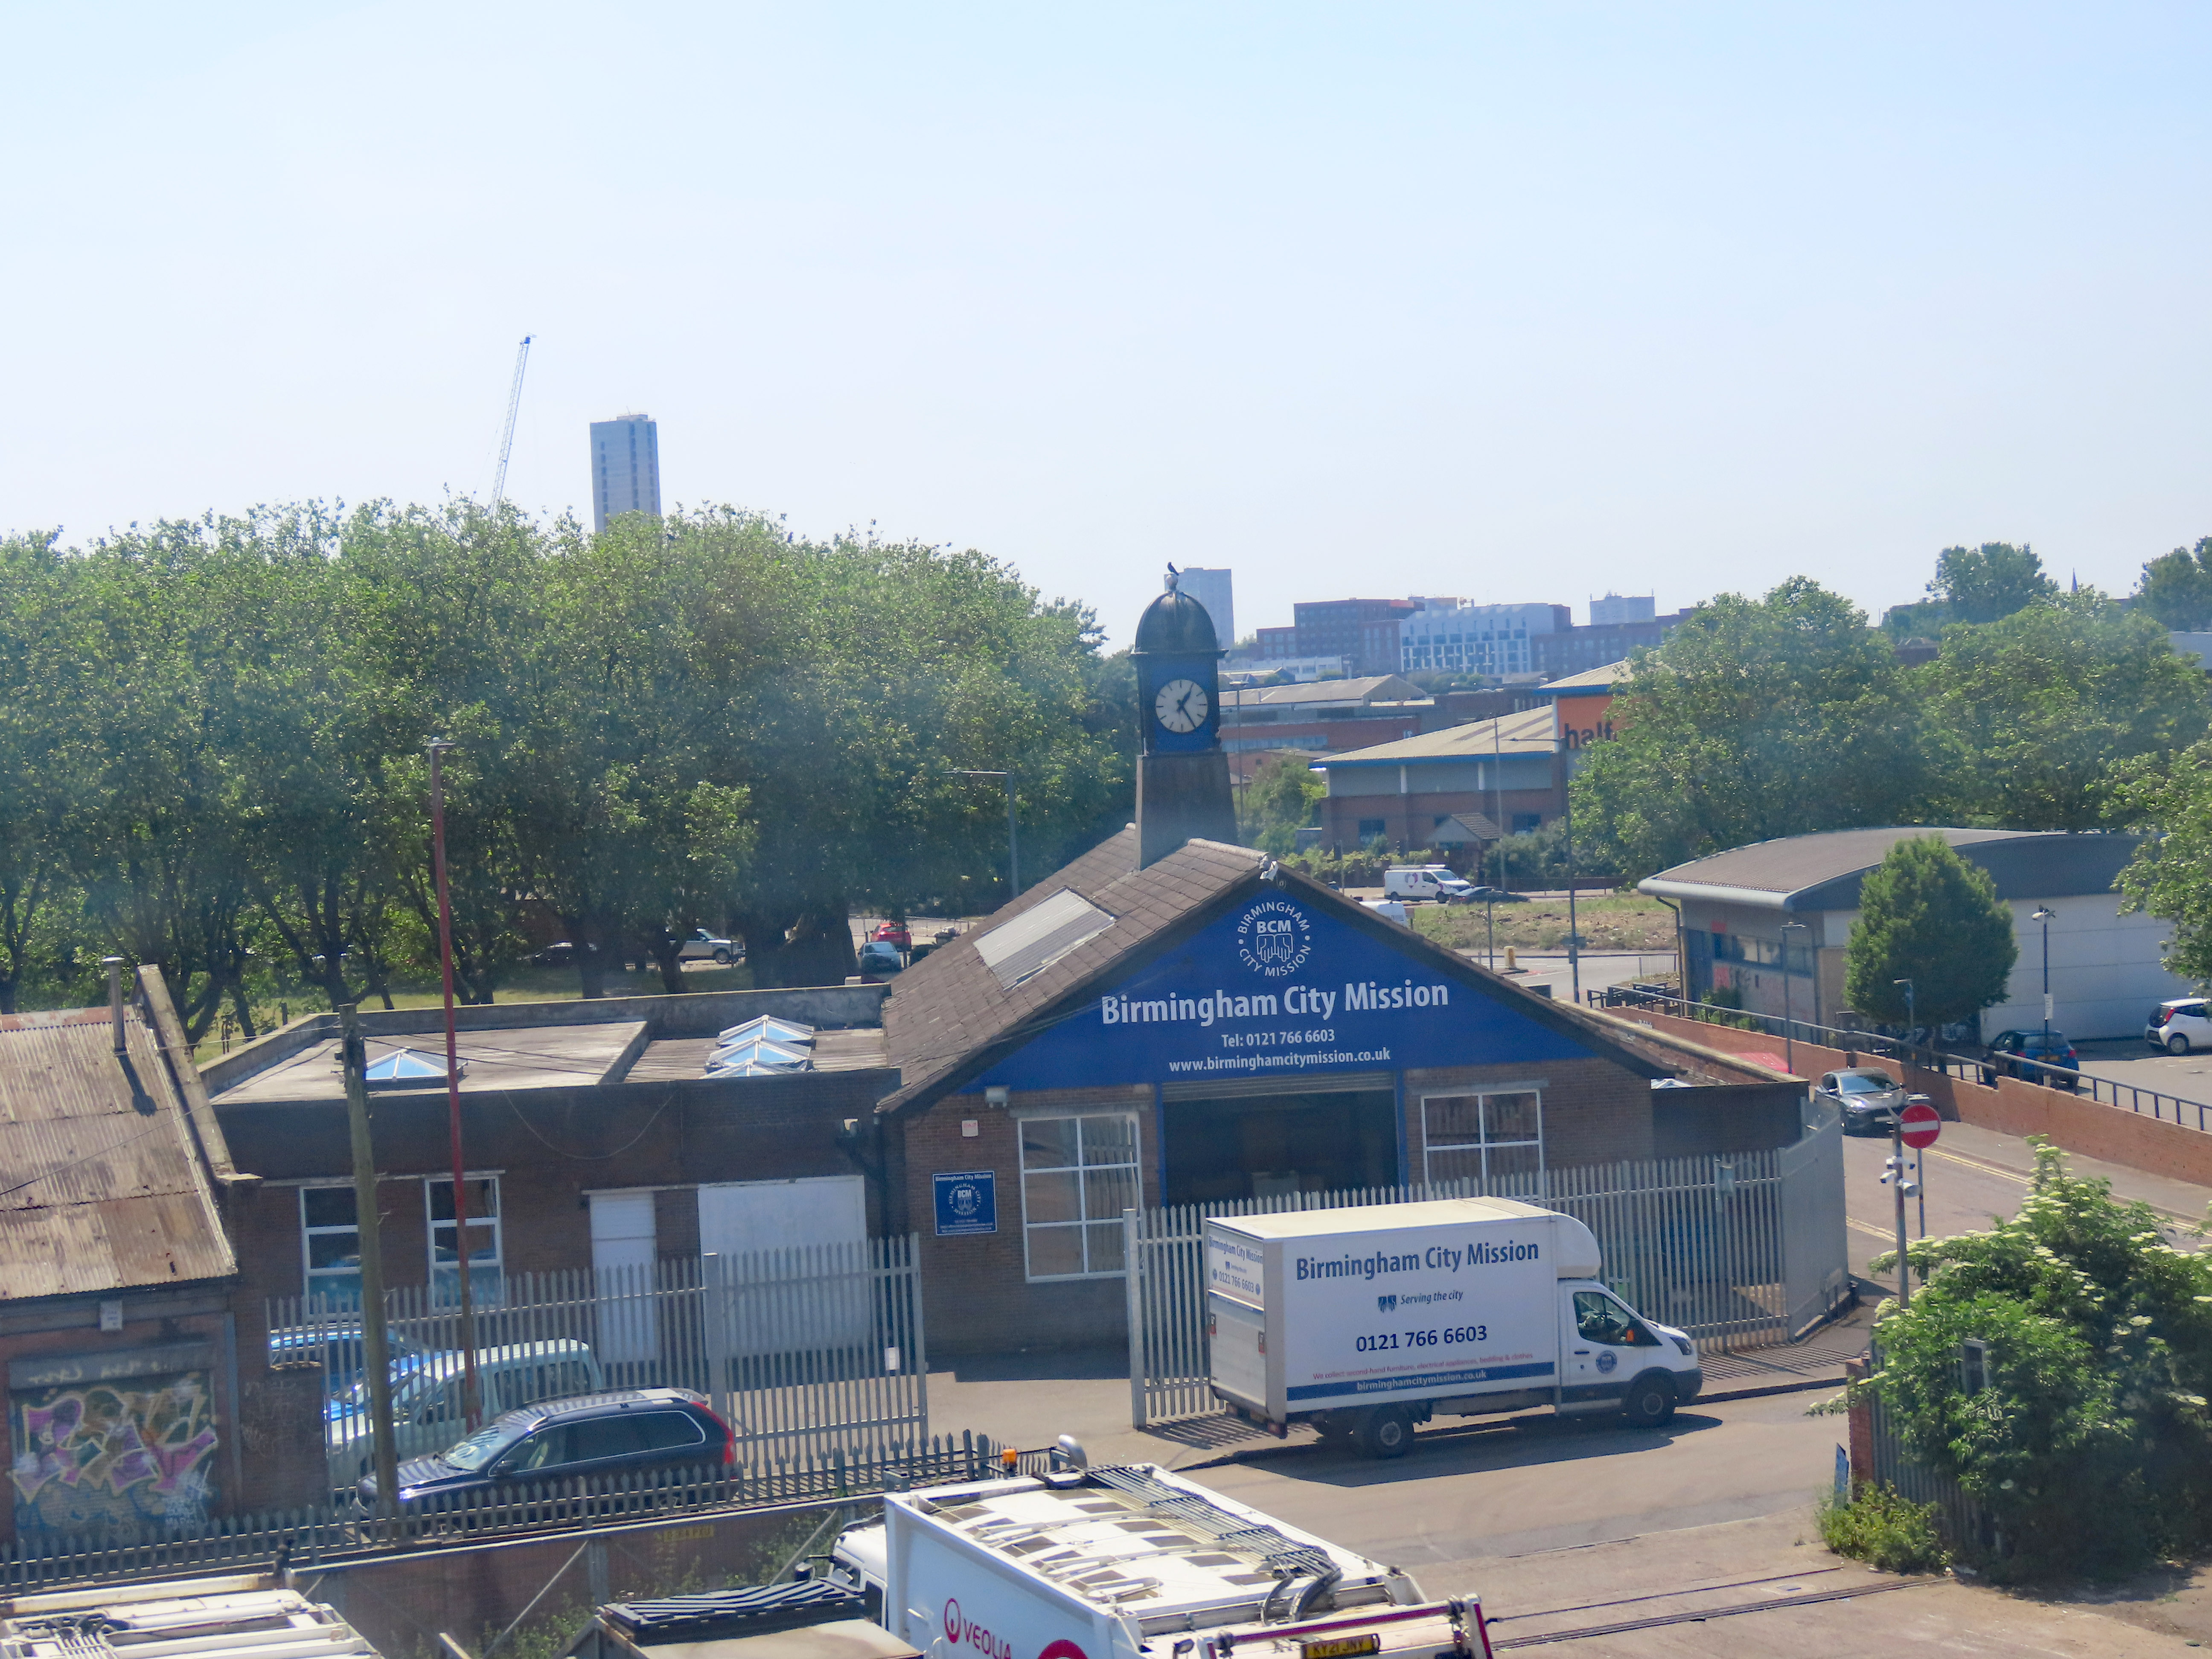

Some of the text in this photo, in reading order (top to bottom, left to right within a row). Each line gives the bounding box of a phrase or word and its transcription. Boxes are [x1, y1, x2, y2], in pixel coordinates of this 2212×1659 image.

[1237, 901, 1310, 934] BIRMINGHAM
[1257, 920, 1292, 934] BCM
[1239, 944, 1311, 977] CITY MISSION
[1102, 979, 1449, 1027] Birmingham City Mission
[1221, 1029, 1336, 1048] Tel: 0121 766 6603
[1169, 1047, 1391, 1071] www.birminghamcitymission.co.uk
[957, 1189, 972, 1198] BCM
[1208, 1236, 1263, 1264] Birmingham City Mission
[1296, 1239, 1540, 1281] Birmingham City Mission
[1219, 1271, 1254, 1292] 0121 766 6603
[1400, 1289, 1464, 1306] Serving the city
[1356, 1325, 1488, 1352] 0121 766 6603
[1357, 1370, 1487, 1391] birminghamcitymission.co.uk
[963, 1618, 1012, 1659] VEOLIA
